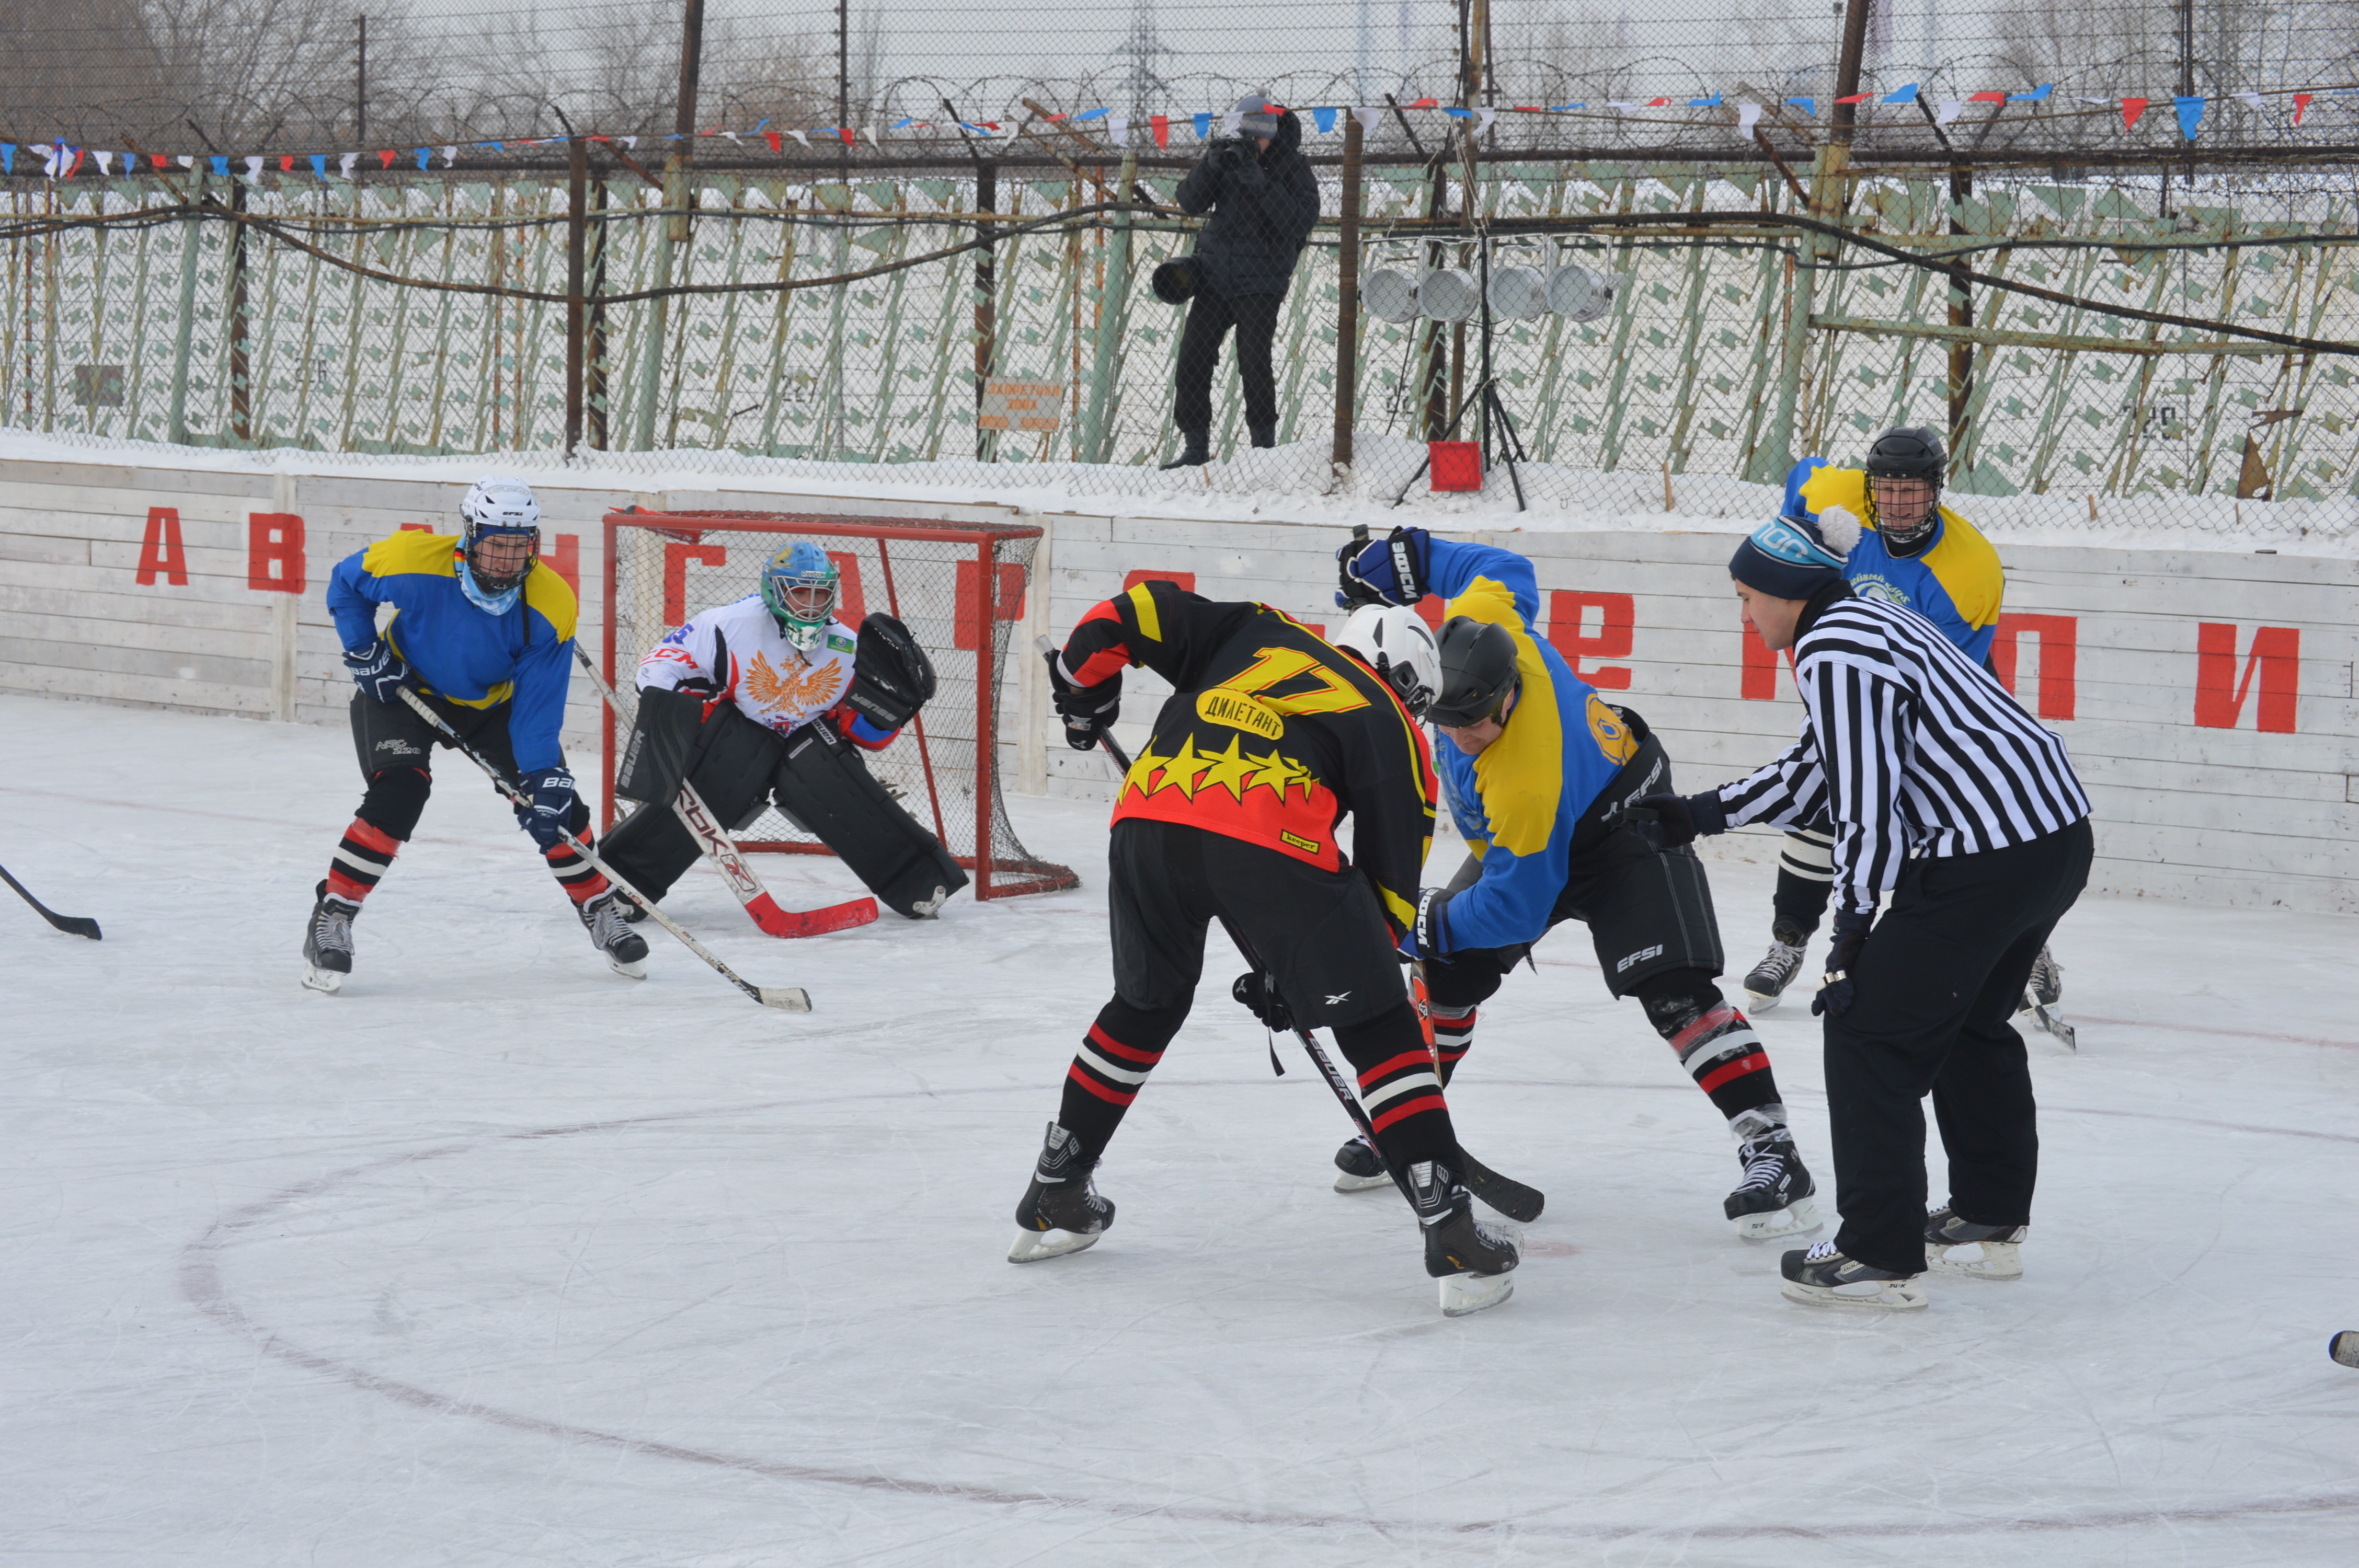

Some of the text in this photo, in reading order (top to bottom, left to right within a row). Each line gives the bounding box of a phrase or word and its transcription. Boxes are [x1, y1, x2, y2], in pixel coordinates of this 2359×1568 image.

[988, 383, 1060, 396] ЗАПРЕТНАЯ
[1006, 399, 1037, 410] ЗОНА
[1212, 647, 1372, 717] 17
[851, 693, 898, 722] BAUER
[1205, 696, 1281, 737] ДИЛЕТАНТ
[375, 740, 407, 751] NRC
[813, 720, 834, 744] AUER
[621, 730, 645, 788] BAUER
[1624, 757, 1663, 808] EFSI
[1287, 834, 1315, 849] keeper
[1617, 944, 1663, 973] EFSI
[1309, 1037, 1353, 1100] BAUER
